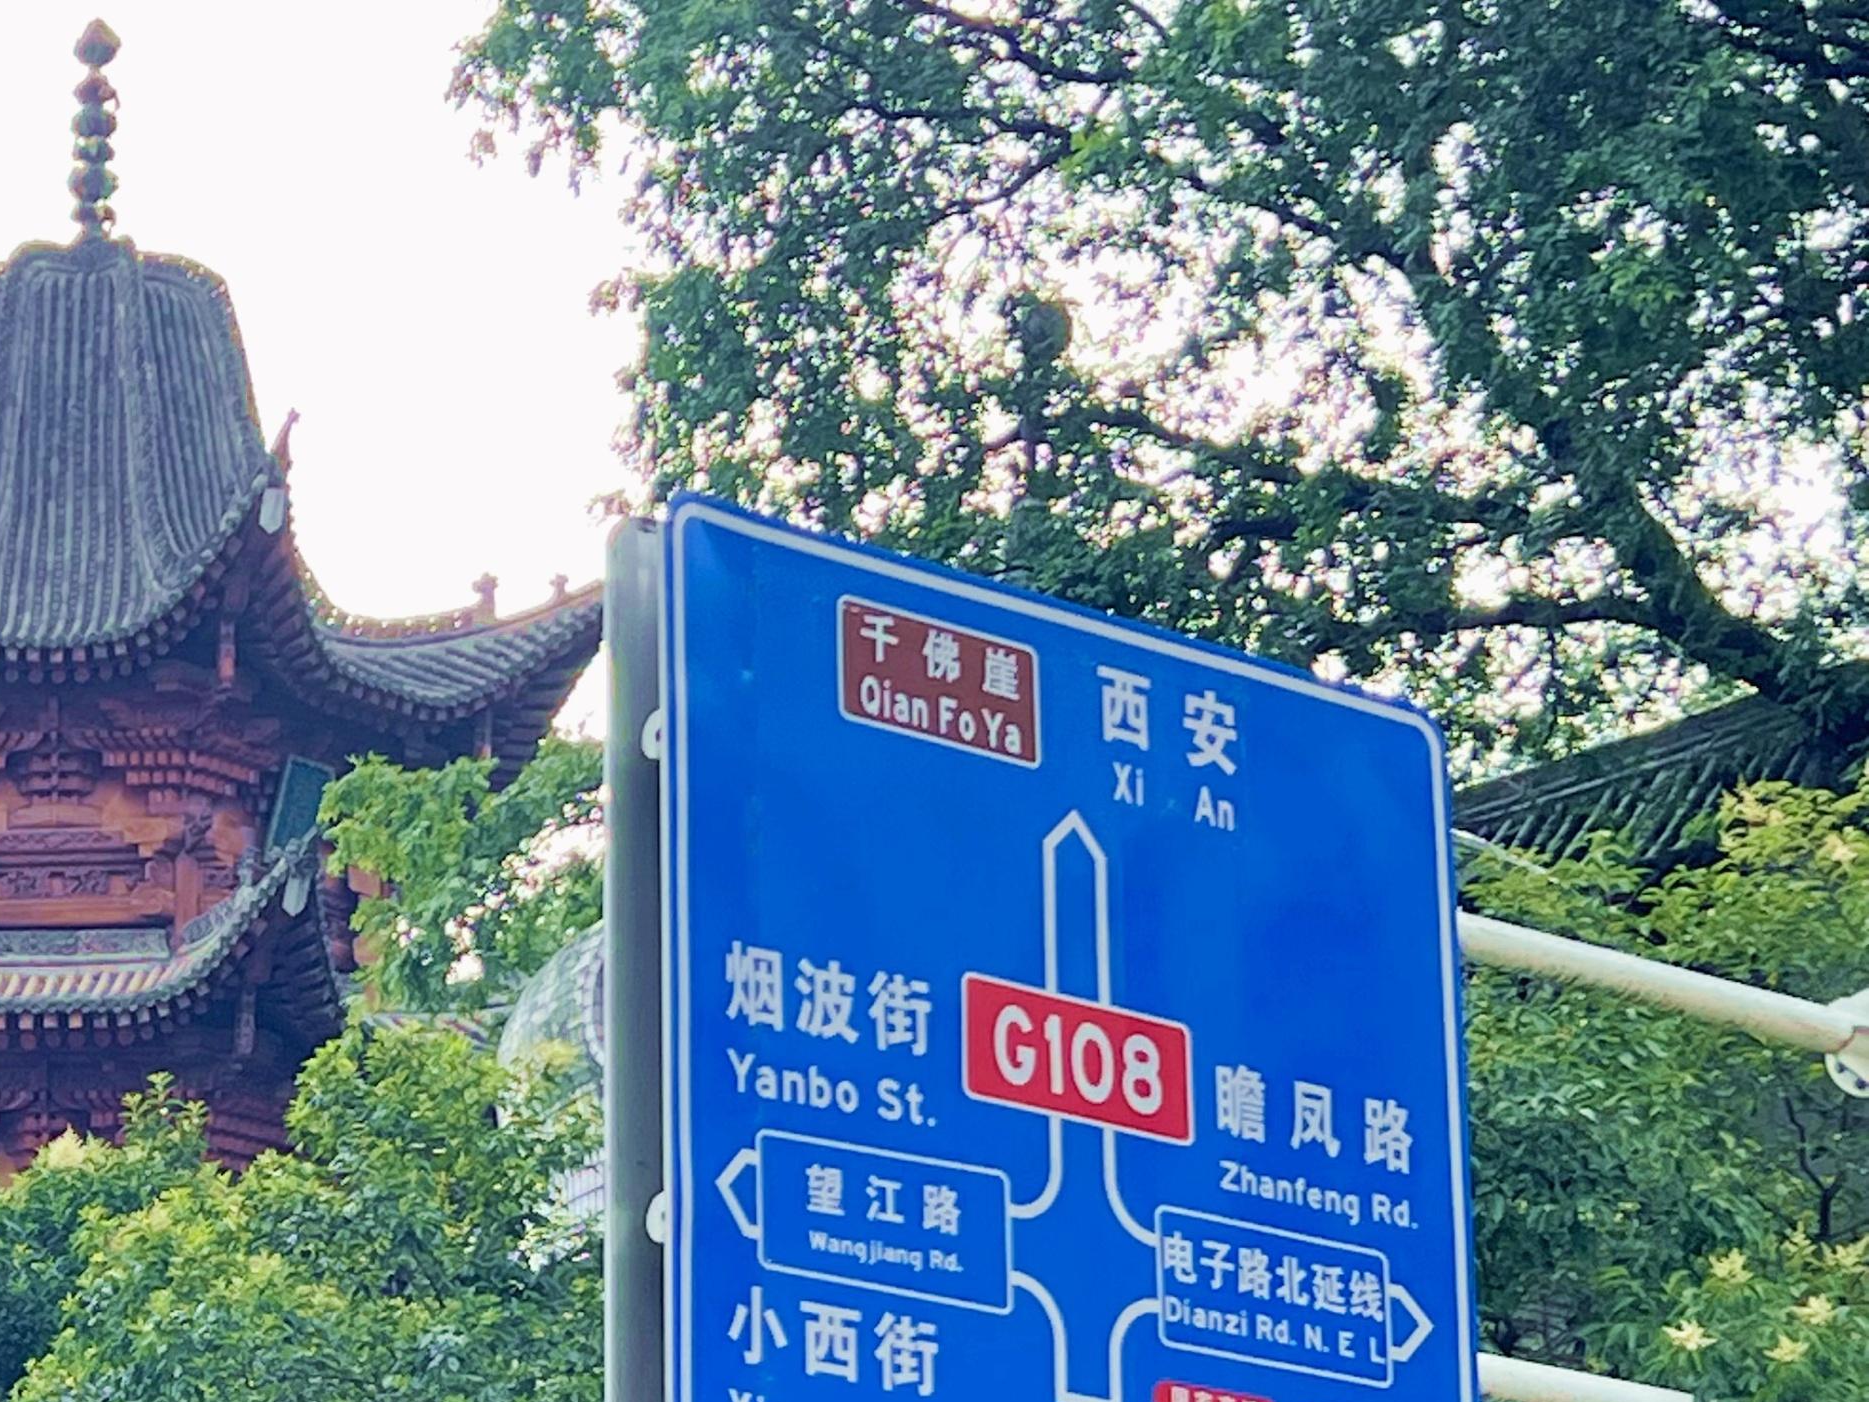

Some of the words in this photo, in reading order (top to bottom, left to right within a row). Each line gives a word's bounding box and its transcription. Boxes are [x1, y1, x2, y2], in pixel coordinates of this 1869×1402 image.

[860, 614, 1021, 702] 千佛崖
[859, 675, 929, 731] Qian
[938, 702, 976, 742] Fo
[981, 707, 1023, 756] Ya
[1096, 664, 1239, 776] 西安
[1113, 761, 1145, 807] Xi
[1194, 787, 1236, 832] An
[725, 940, 932, 1057] 烟波街
[728, 1048, 860, 1116] Yanbo
[877, 1077, 938, 1128] St.
[992, 1003, 1163, 1116] G108
[1215, 1063, 1413, 1176] 瞻凤路
[806, 1163, 962, 1236] 望江路
[1218, 1160, 1359, 1230] Zhanfeng
[1371, 1191, 1420, 1230] Rd.
[808, 1230, 922, 1272] Wangjiang
[930, 1247, 964, 1274] Rd.
[1163, 1230, 1384, 1322] 电子路北延线
[728, 1285, 939, 1398] 小西街
[1165, 1296, 1248, 1336] Dianzi
[1256, 1314, 1297, 1346] Rd.
[1304, 1323, 1330, 1353] N.
[1338, 1330, 1356, 1358] E
